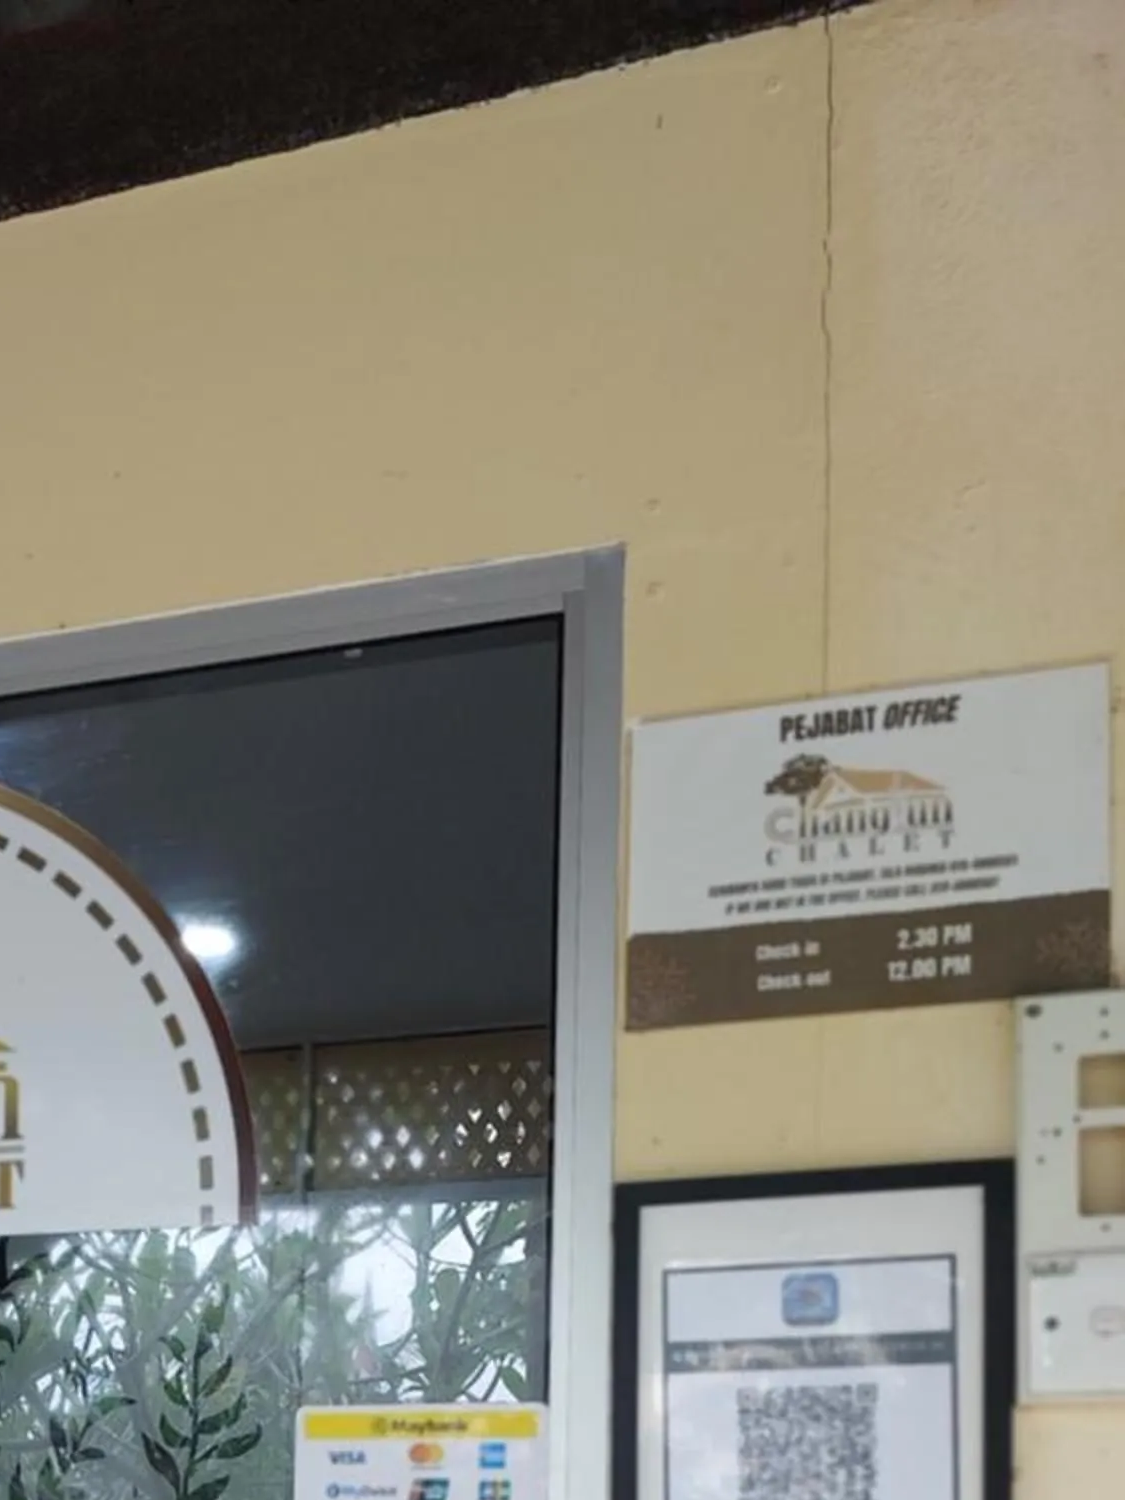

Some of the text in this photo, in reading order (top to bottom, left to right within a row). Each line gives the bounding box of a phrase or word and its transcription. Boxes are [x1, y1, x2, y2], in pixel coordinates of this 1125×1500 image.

[780, 694, 962, 743] PEJABAT OFFICE
[763, 796, 954, 844] Changun
[755, 923, 973, 961] Check in 2.30 PM
[756, 953, 972, 992] Check out 12.00 PM
[391, 1418, 468, 1435] Maybank
[329, 1451, 367, 1465] VISA
